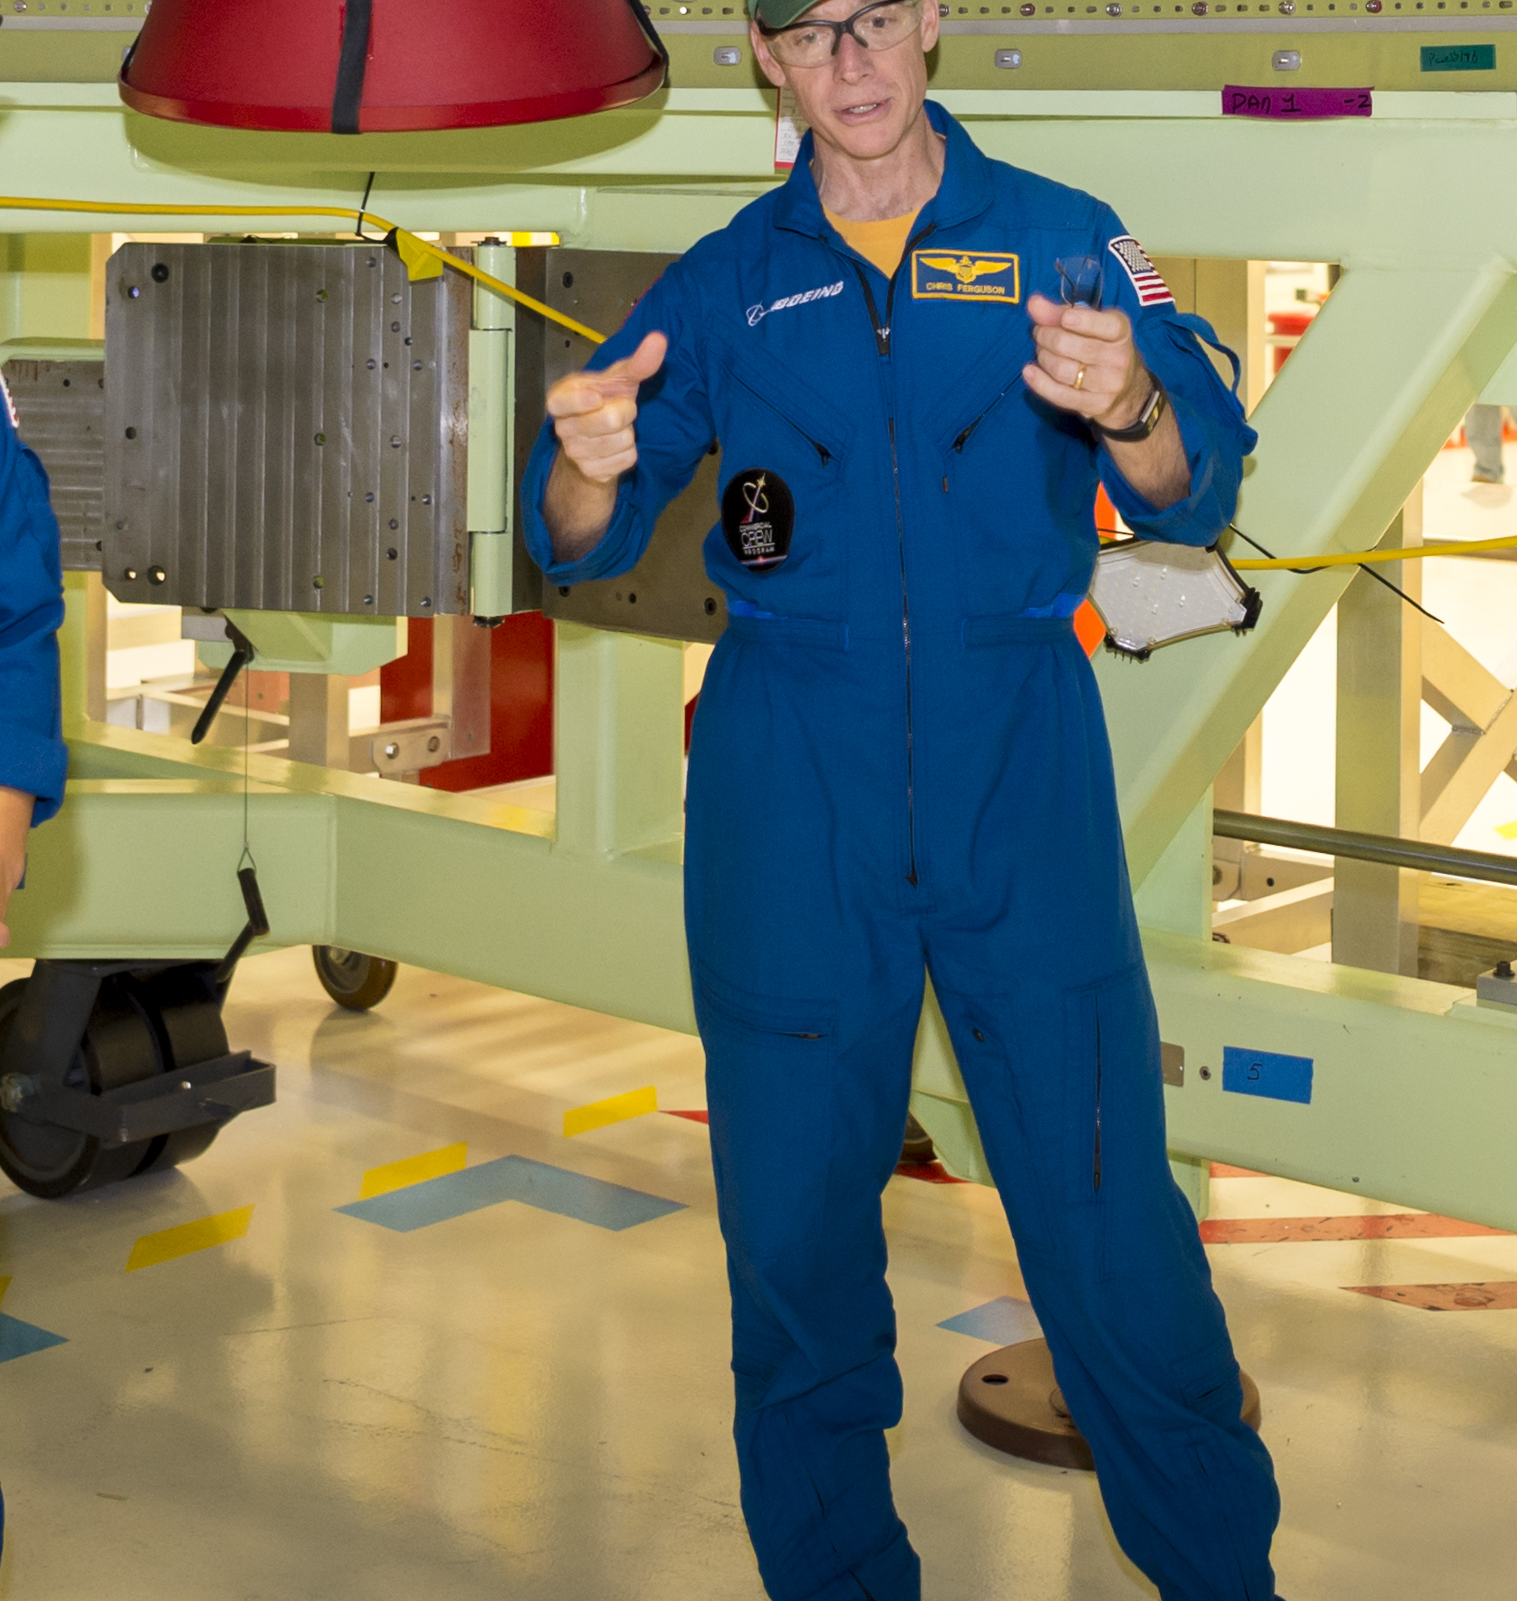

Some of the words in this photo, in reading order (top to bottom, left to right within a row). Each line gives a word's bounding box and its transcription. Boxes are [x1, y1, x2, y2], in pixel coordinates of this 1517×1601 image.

[770, 280, 844, 311] BOEING
[926, 282, 953, 292] CHRIS
[957, 283, 1005, 295] FERGUSON
[741, 529, 773, 548] CREW
[1246, 1063, 1263, 1081] 5
